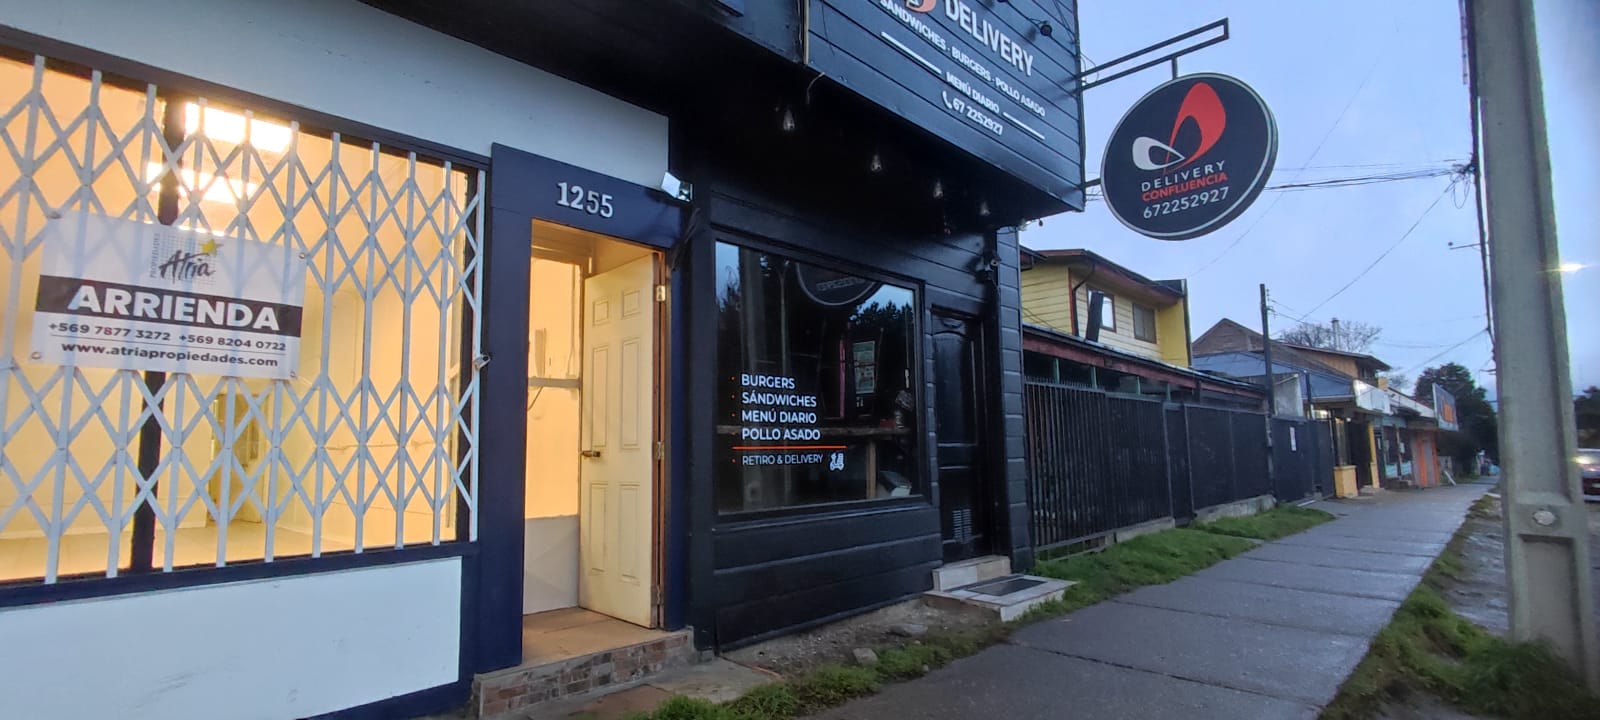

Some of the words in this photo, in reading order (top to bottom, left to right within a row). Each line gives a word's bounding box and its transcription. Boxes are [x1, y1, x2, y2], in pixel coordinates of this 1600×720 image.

[946, 0, 1033, 76] DELIVERY
[946, 72, 971, 96] MENÚ
[972, 89, 1000, 114] DIARIO
[952, 46, 991, 82] BURGERS
[995, 77, 1020, 101] POLLO
[1021, 95, 1046, 116] ASADO
[953, 98, 965, 113] 67
[966, 106, 1003, 135] 2252927
[1141, 160, 1225, 192] DELIVERY
[1142, 172, 1228, 202] CONFLUENCIA
[557, 182, 614, 218] 1255
[1143, 187, 1229, 219] 672252927
[67, 285, 280, 331] ARRIENDA
[48, 322, 90, 334] +569
[94, 325, 131, 337] 7877
[135, 329, 171, 341] 3272
[179, 334, 214, 345] +569
[217, 337, 252, 348] 8204
[255, 340, 286, 351] 0722
[61, 342, 278, 367] www.atriapropiedades.com
[741, 374, 795, 389] BURGERS
[742, 390, 817, 407] SÁNDWICHES
[742, 408, 776, 422] MENÚ
[780, 412, 817, 423] DIARIO
[742, 428, 781, 440] POLLO
[783, 428, 821, 440] ASADO
[742, 454, 776, 466] RETIRO
[776, 455, 783, 465] &
[784, 454, 823, 464] DELIVERY
